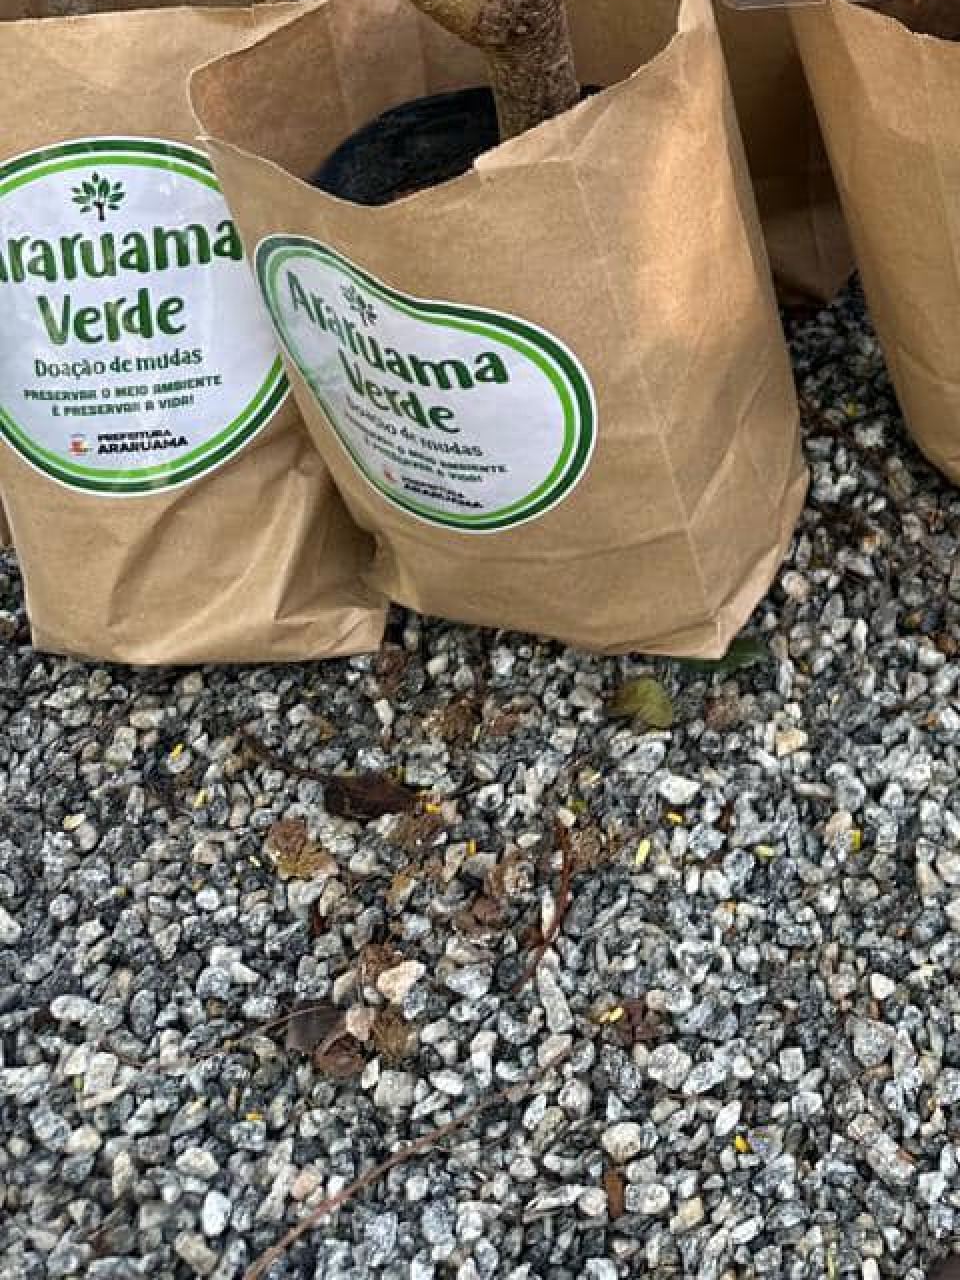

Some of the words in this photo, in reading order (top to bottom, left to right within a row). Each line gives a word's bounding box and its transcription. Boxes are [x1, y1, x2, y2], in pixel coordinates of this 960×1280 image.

[36, 288, 187, 346] Verde
[286, 269, 510, 391] Araruama
[34, 357, 106, 380] Doação
[109, 356, 133, 373] de
[136, 348, 203, 371] mudas
[114, 385, 149, 398] MEIO
[338, 347, 461, 434] Verde
[98, 435, 188, 454] ARARUAMA
